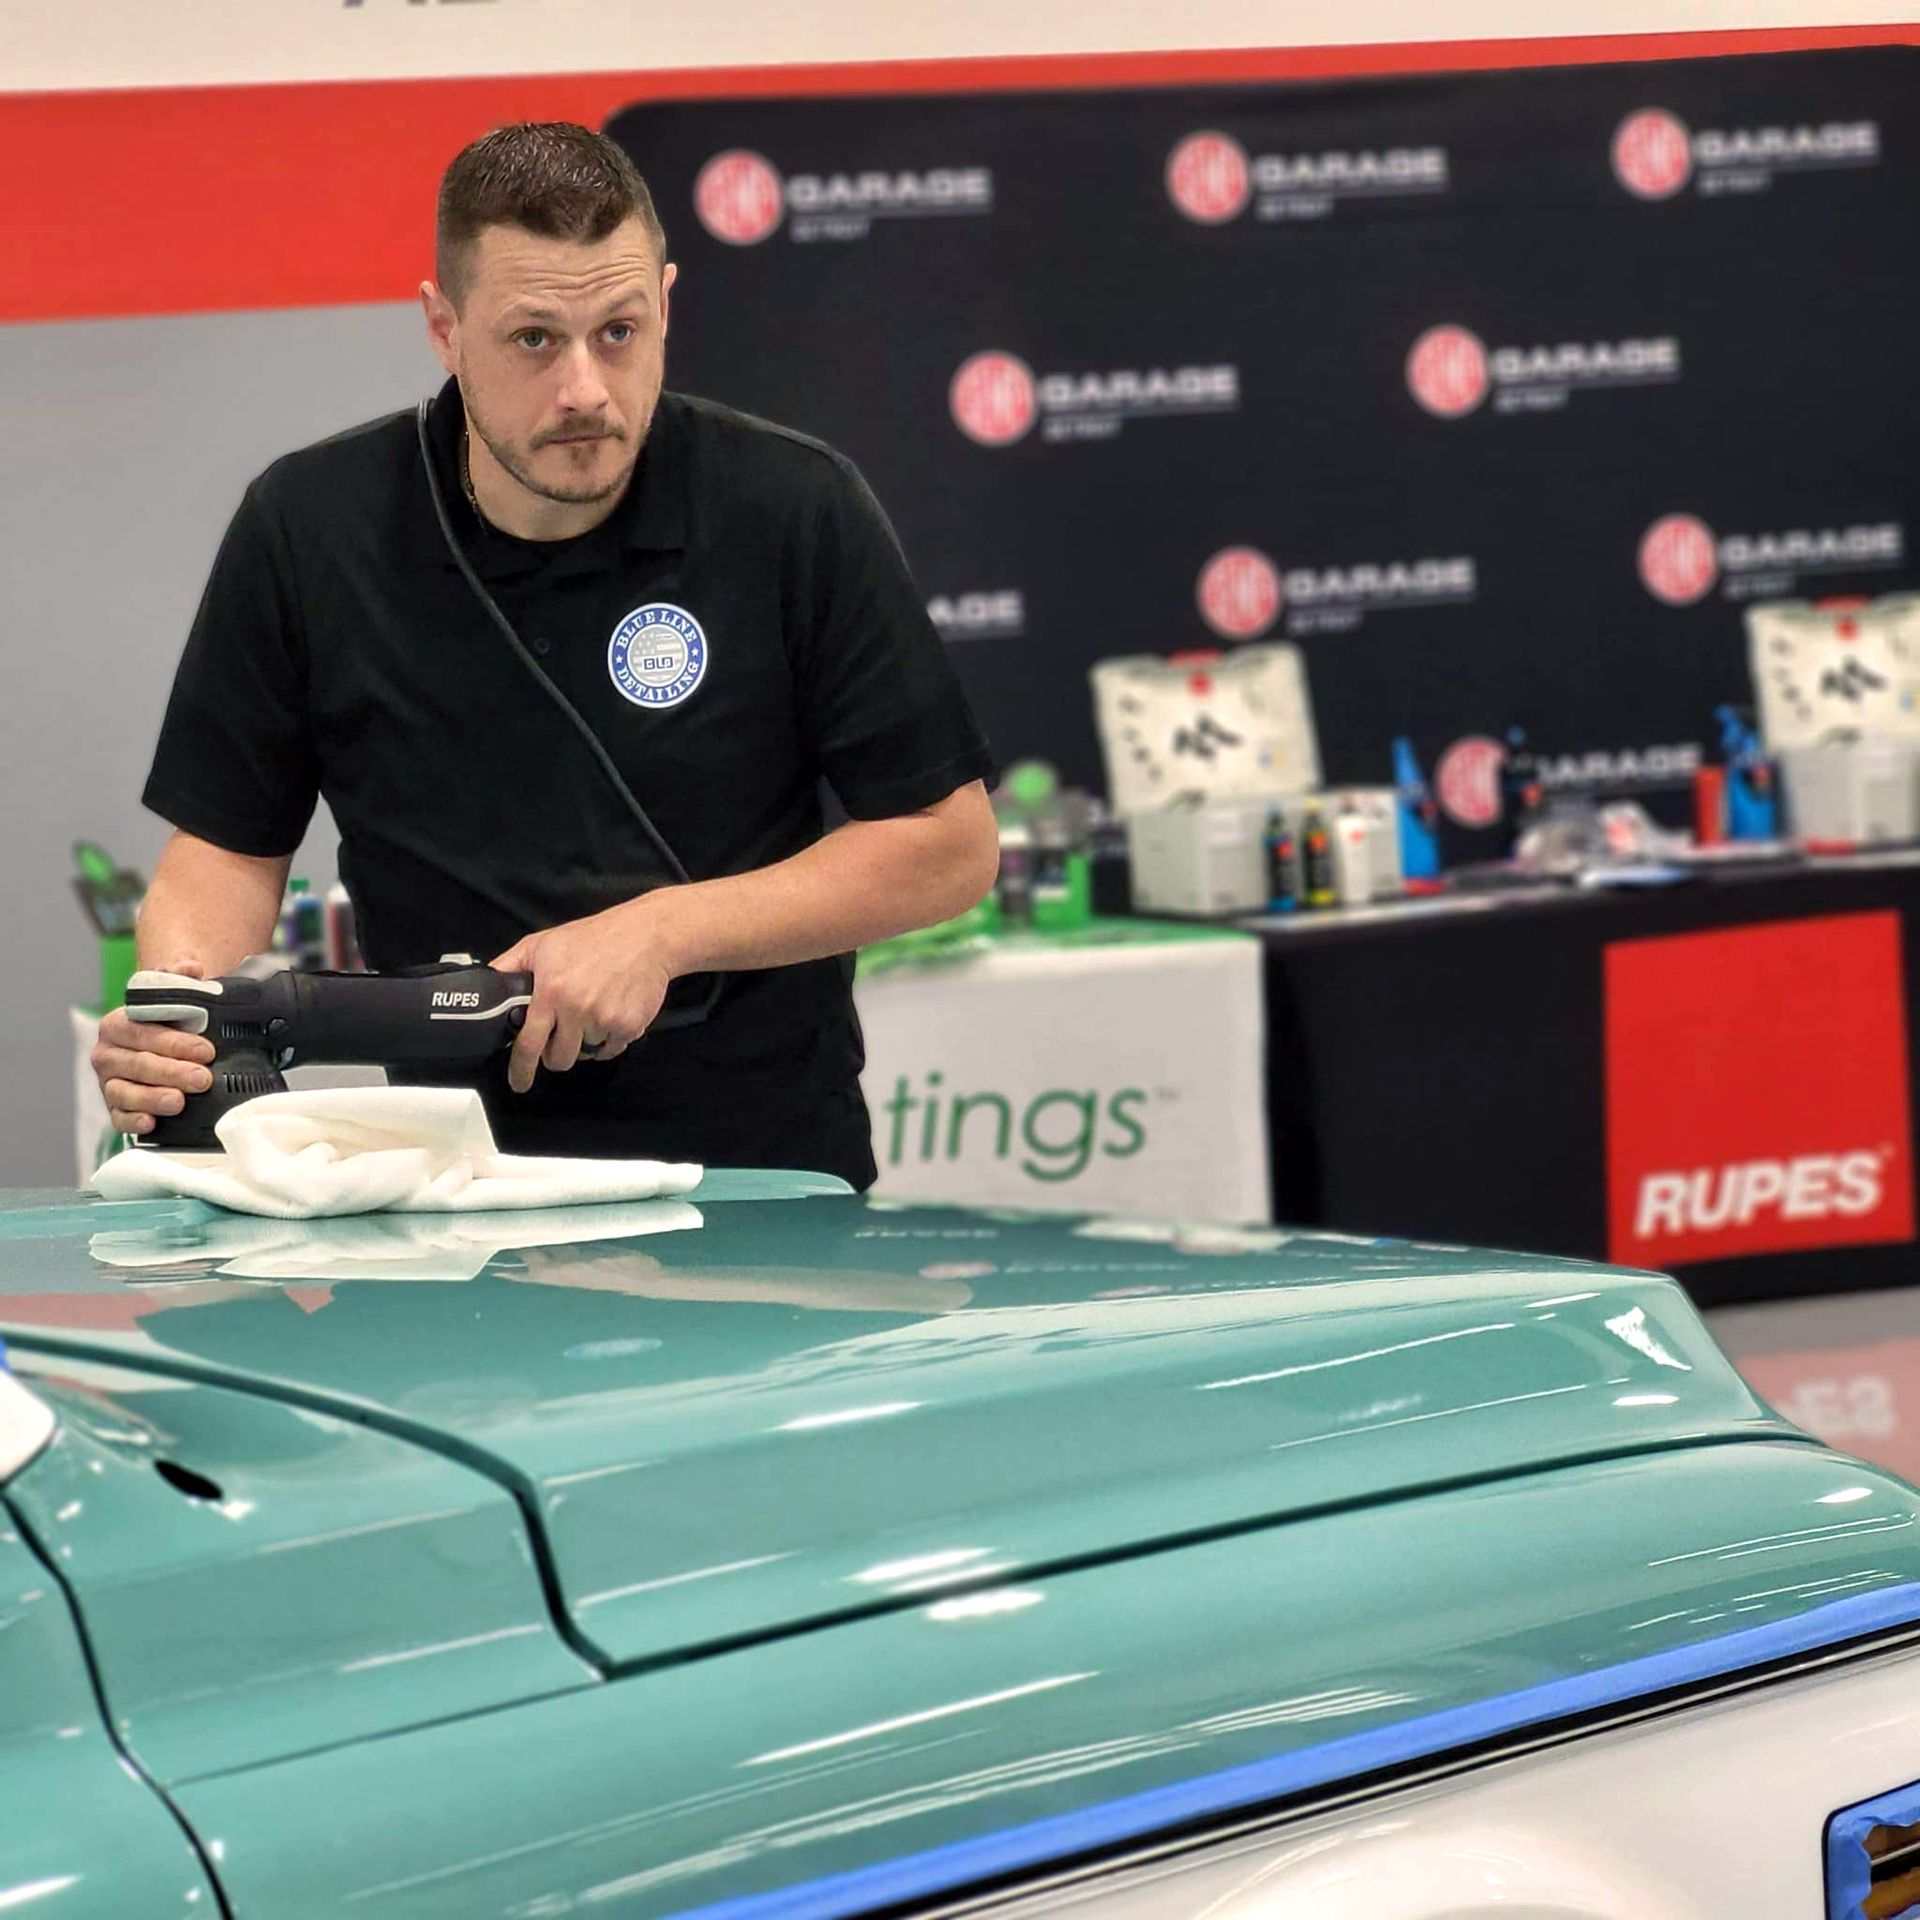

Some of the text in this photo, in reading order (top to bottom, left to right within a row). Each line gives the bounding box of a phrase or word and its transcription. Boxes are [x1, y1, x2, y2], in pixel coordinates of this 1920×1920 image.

[1694, 120, 1876, 166] GARAGE
[786, 168, 990, 211] GARAGE
[1252, 148, 1447, 191] GARAGE
[1491, 337, 1678, 384] GARAGE
[1038, 365, 1237, 410] GARAGE
[1720, 523, 1899, 571] GARAGE
[1284, 558, 1474, 603] GARAGE
[616, 610, 698, 649] BLUE LINE
[617, 661, 700, 701] DETAILING
[1535, 743, 1699, 784] ARAGE
[431, 991, 481, 1007] RUPES
[883, 1071, 1147, 1183] tings
[1635, 1153, 1884, 1240] RUPES
